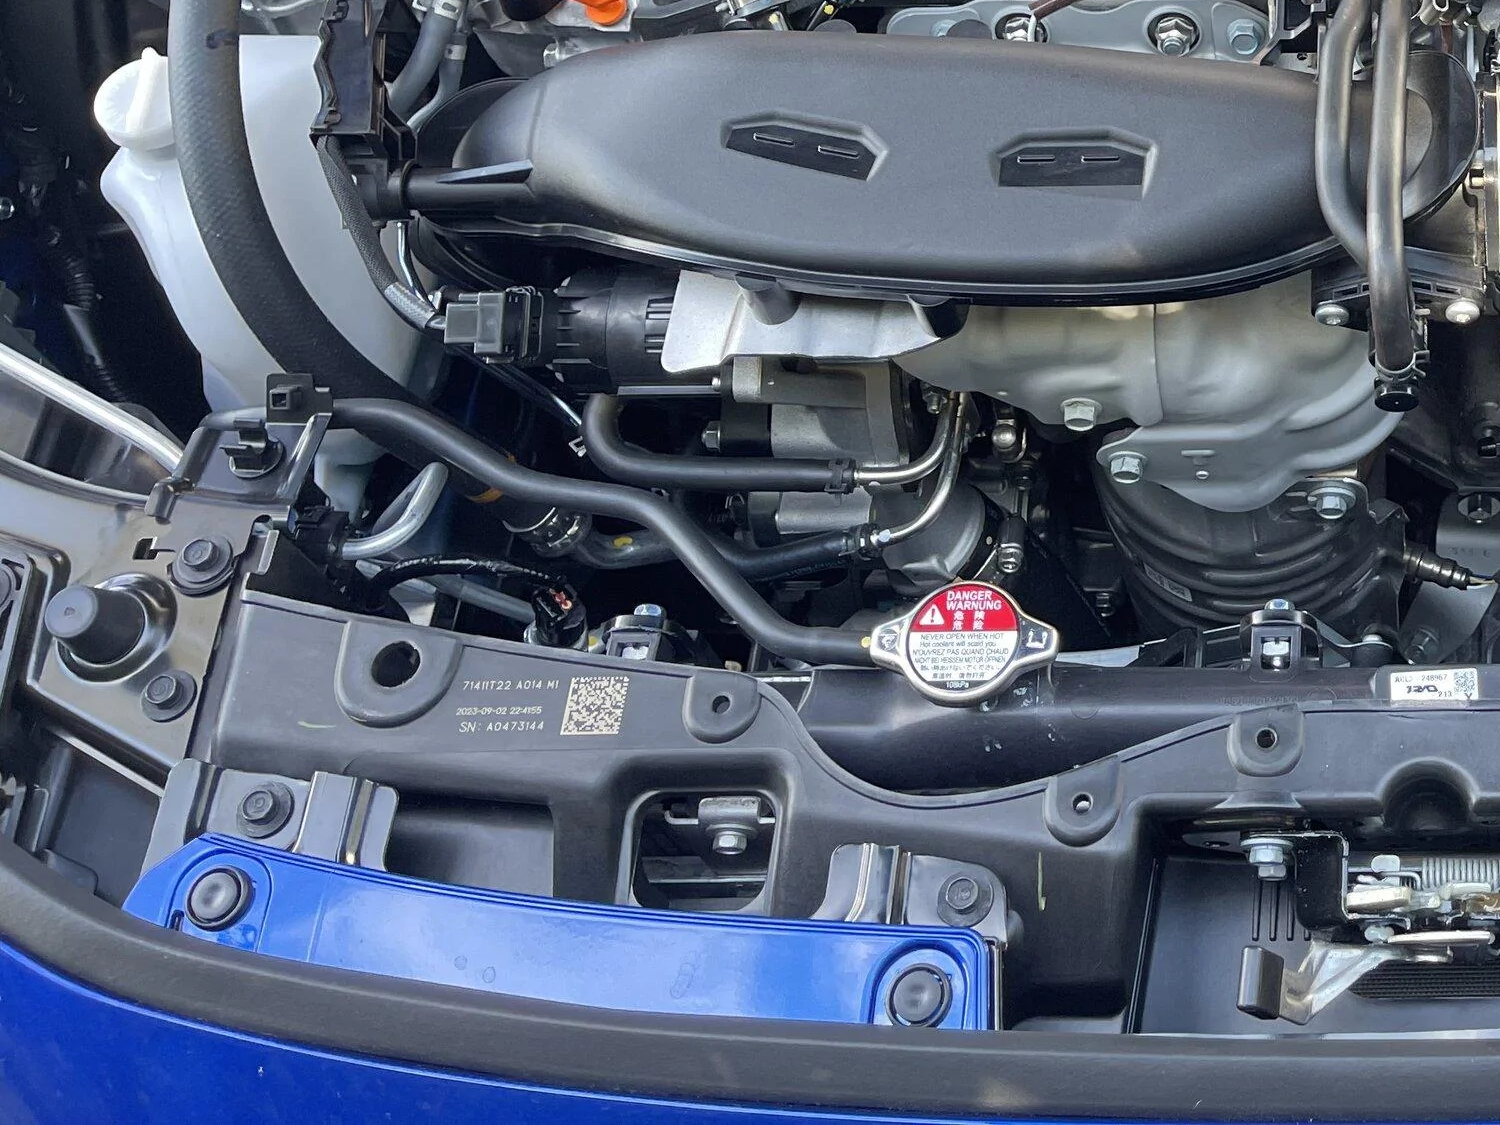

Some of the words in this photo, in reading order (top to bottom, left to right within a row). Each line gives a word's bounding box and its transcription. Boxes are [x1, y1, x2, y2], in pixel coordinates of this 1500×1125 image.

[946, 590, 993, 601] DANGER
[946, 600, 1002, 611] WARNUNG
[515, 679, 542, 690] A014
[456, 706, 507, 716] 2023-09-02
[486, 721, 544, 732] A0473144
